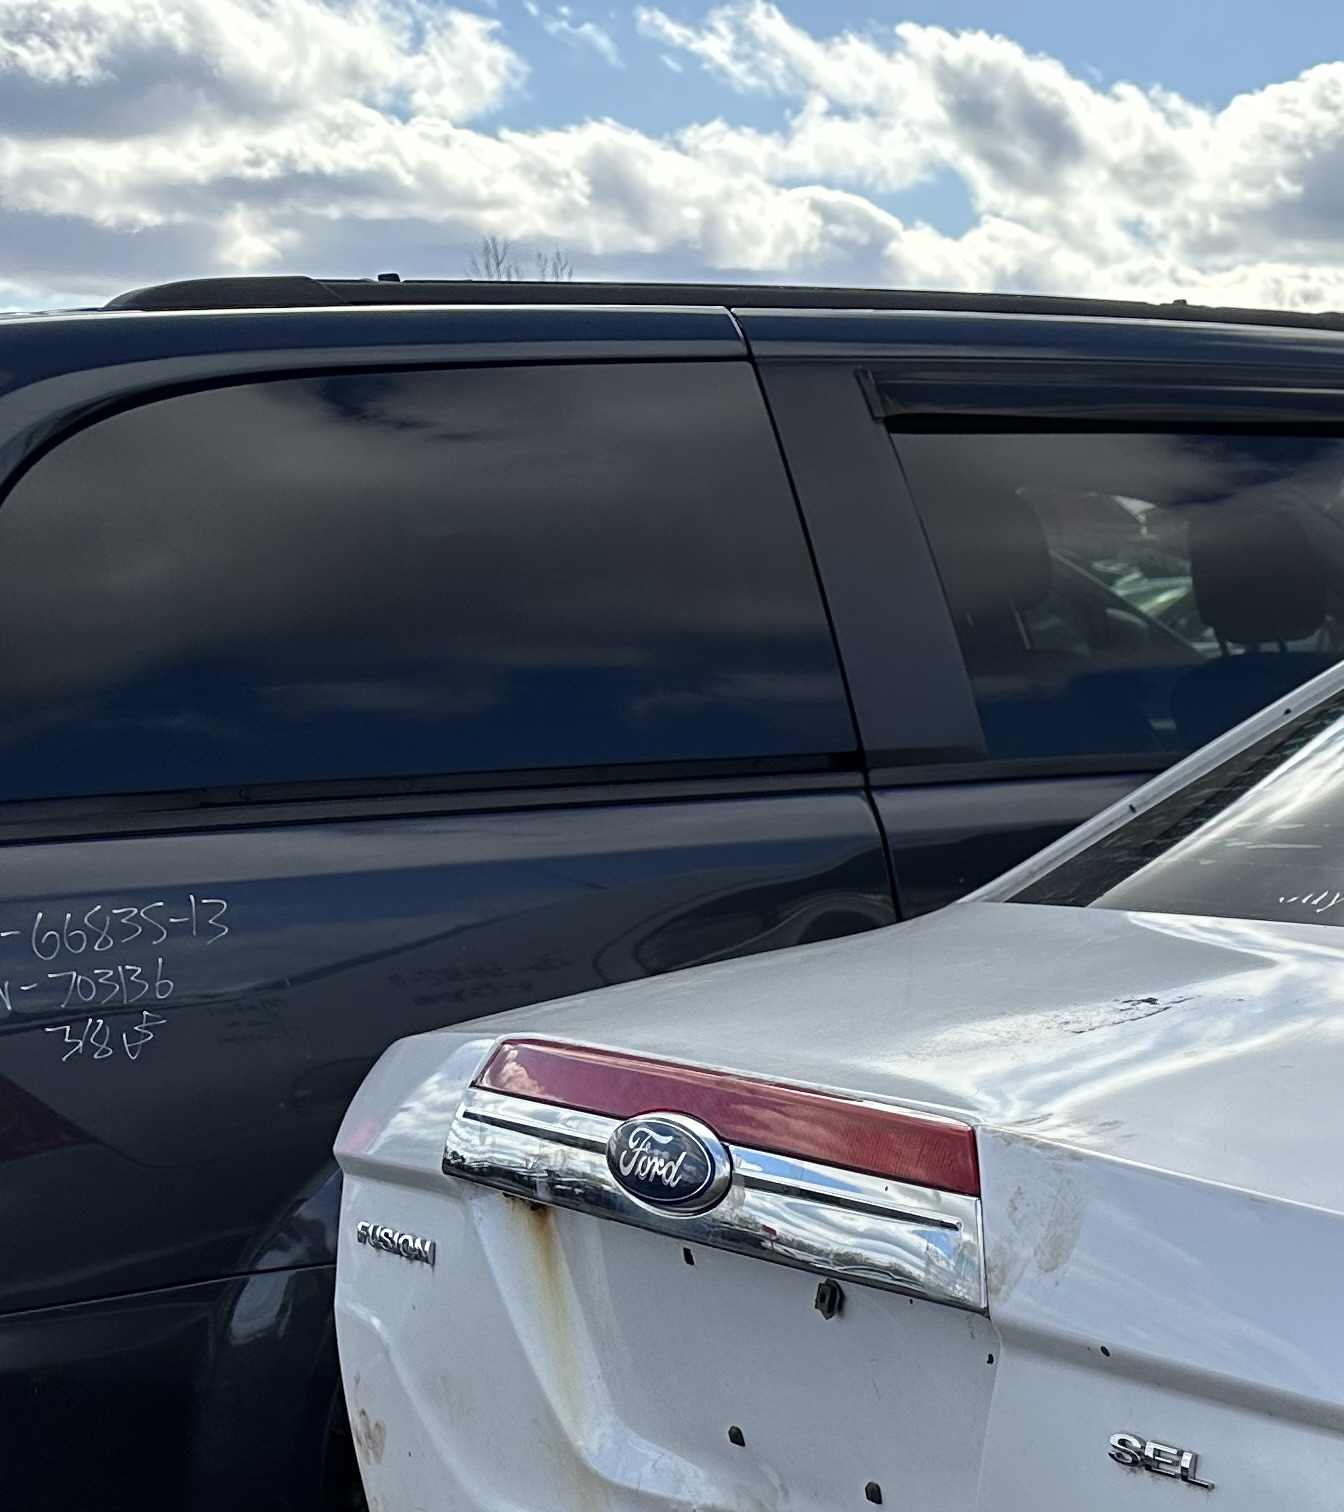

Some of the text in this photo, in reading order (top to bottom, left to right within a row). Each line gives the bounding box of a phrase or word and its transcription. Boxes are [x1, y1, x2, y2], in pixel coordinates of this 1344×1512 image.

[619, 1126, 688, 1188] Ford
[356, 1220, 437, 1267] FUSION
[1107, 1432, 1216, 1491] SEL
